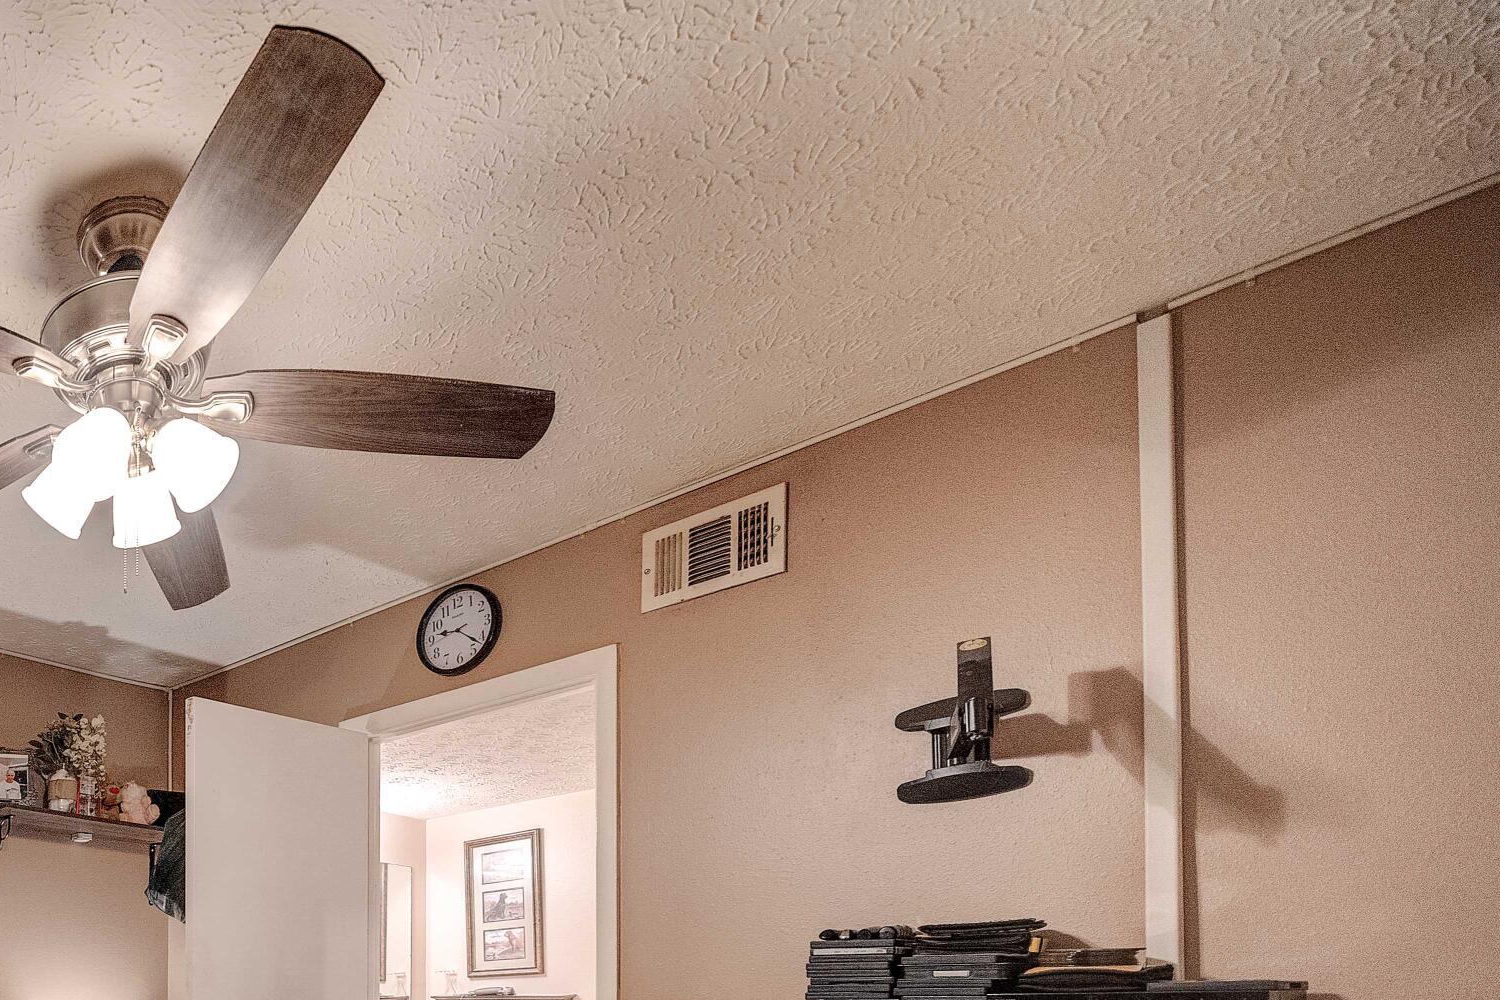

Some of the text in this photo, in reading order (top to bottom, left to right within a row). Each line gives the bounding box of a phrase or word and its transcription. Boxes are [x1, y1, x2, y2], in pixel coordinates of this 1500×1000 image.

[452, 596, 463, 610] 12
[478, 600, 484, 612] 2
[441, 606, 450, 618] 11
[432, 619, 443, 632] 10
[484, 614, 490, 626] 3
[428, 635, 435, 646] 9
[479, 630, 485, 641] 4
[434, 648, 440, 659] 8
[470, 644, 476, 656] 5
[444, 654, 450, 665] 7
[456, 652, 464, 664] 6
